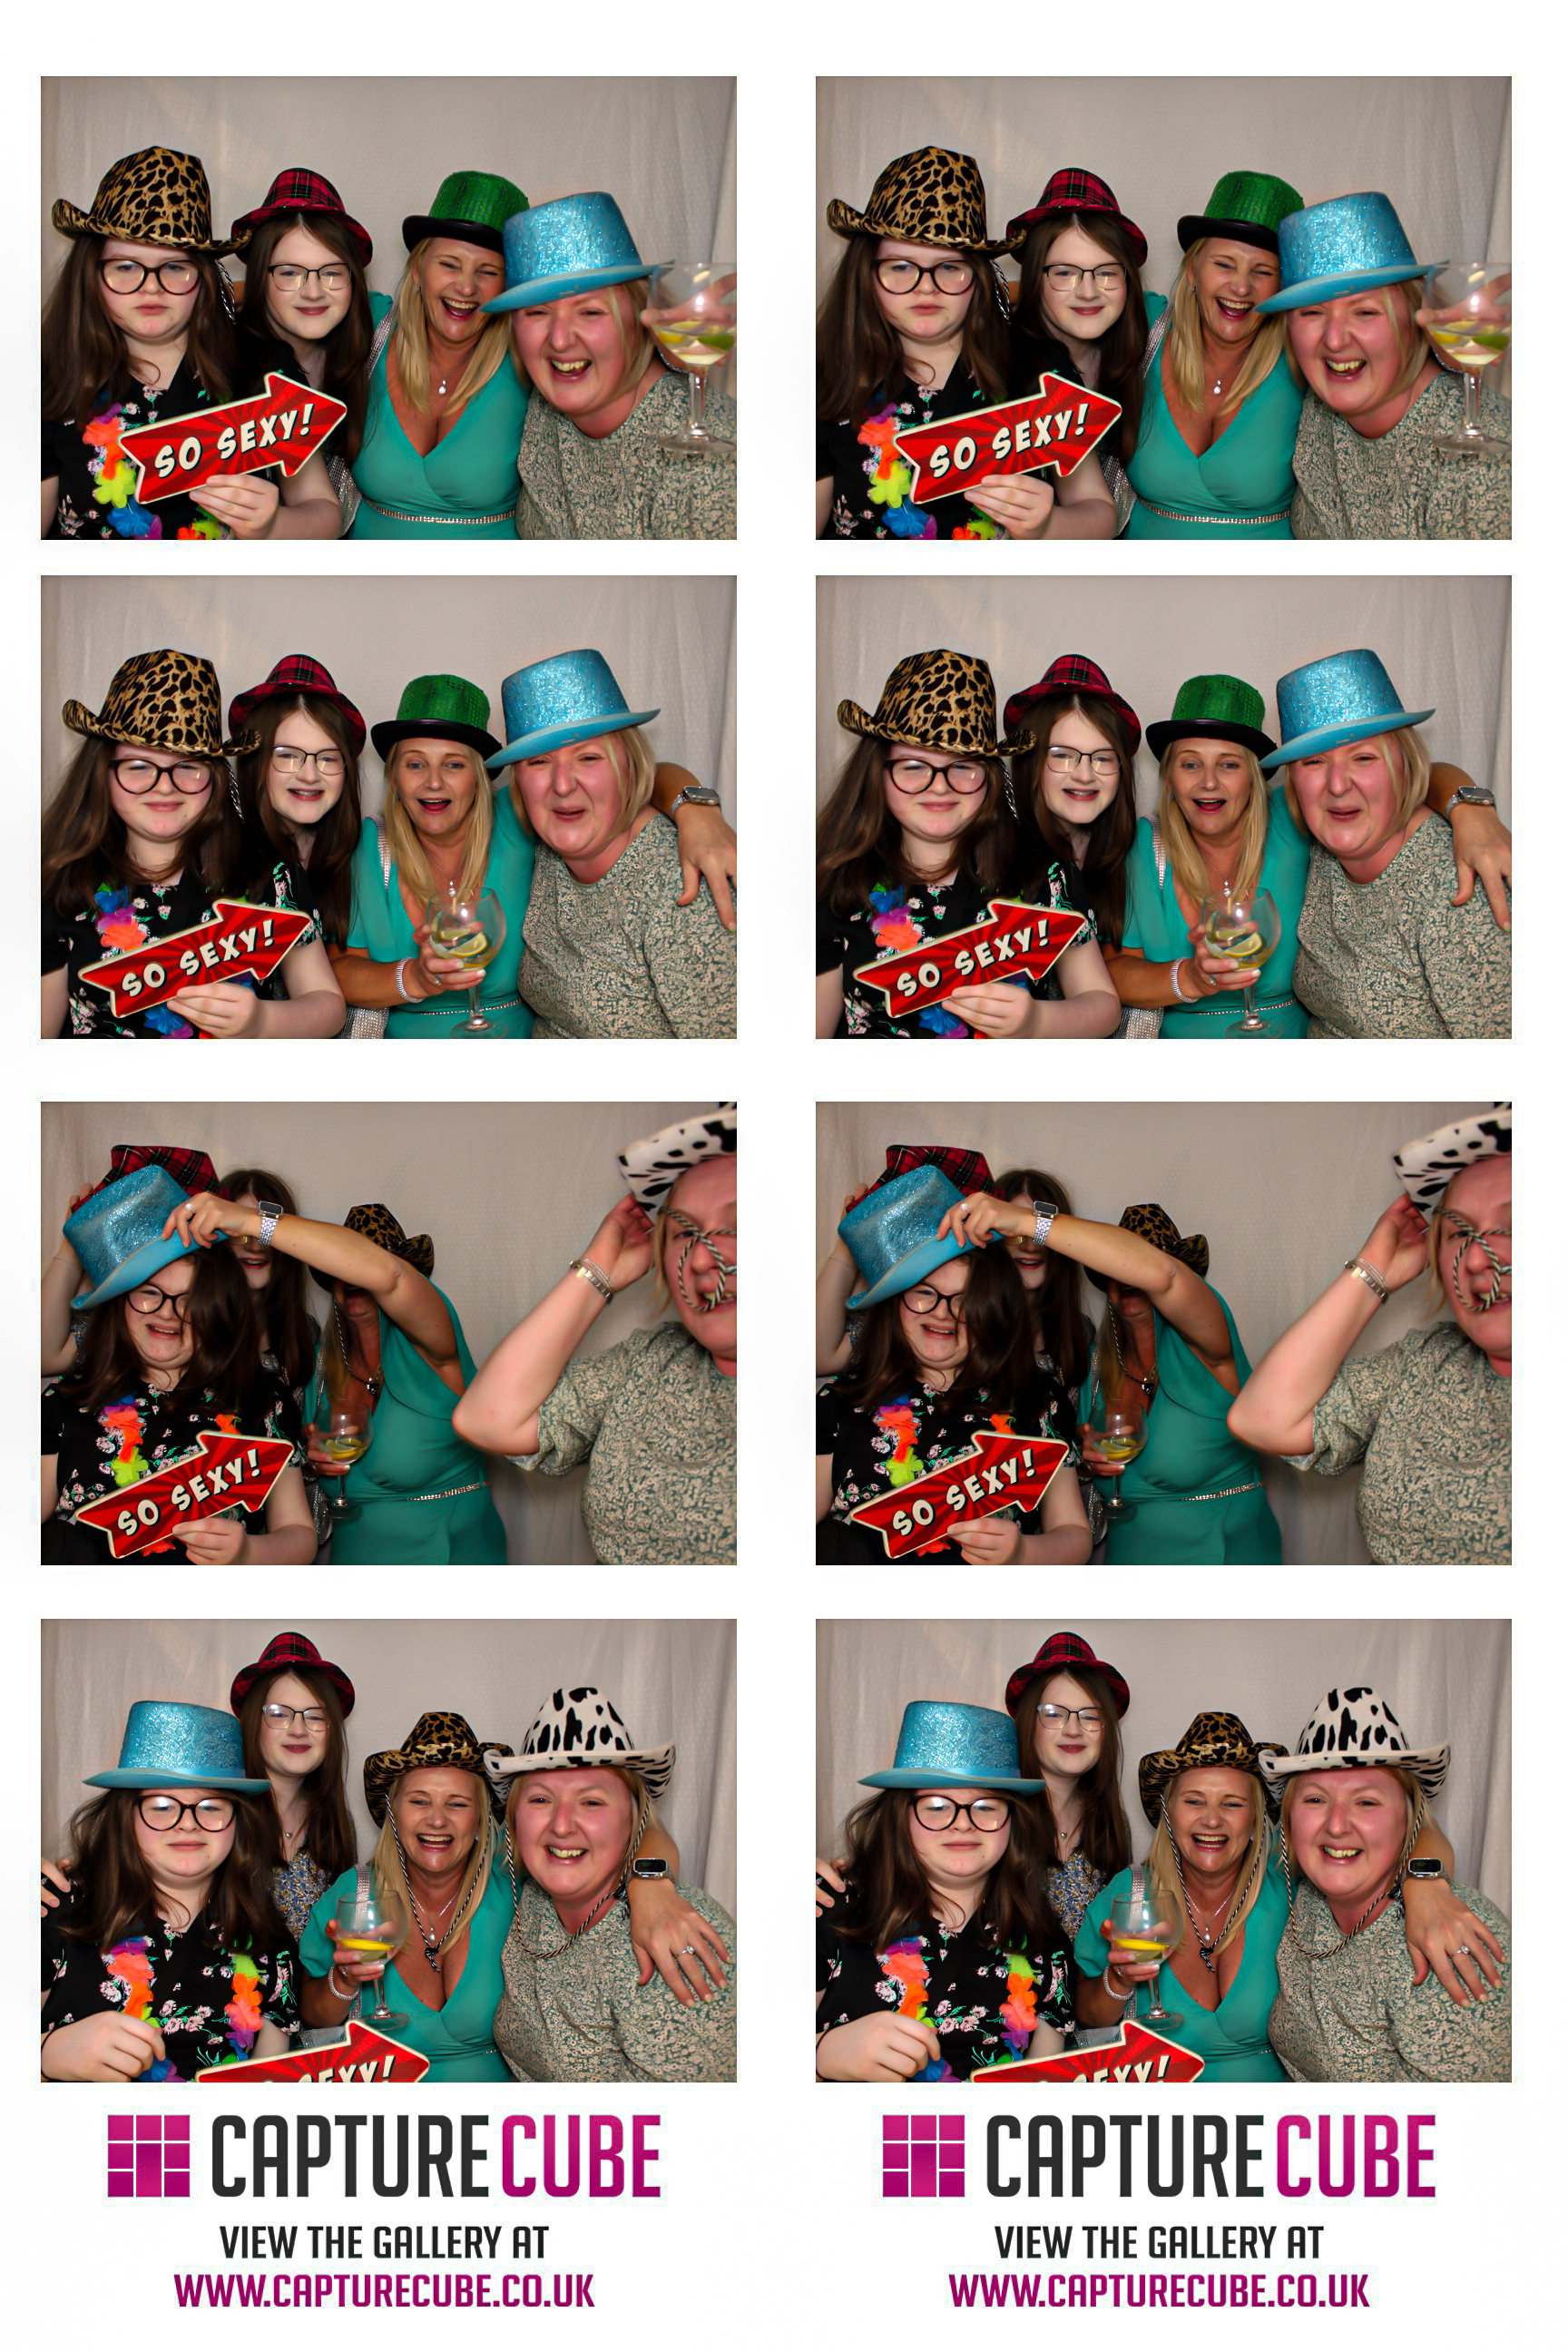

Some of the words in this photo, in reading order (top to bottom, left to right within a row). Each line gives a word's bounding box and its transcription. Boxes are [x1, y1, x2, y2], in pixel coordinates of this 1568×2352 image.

[154, 436, 202, 478] SO
[217, 403, 315, 460] SEXY!
[929, 436, 977, 478] SO
[992, 403, 1090, 460] SEXY!
[122, 963, 166, 997] SO
[179, 919, 275, 975] SEXY!
[897, 963, 941, 997] SO
[954, 919, 1050, 975] SEXY!
[117, 1499, 160, 1536] SO
[171, 1448, 261, 1511] SEXY!
[892, 1499, 935, 1536] SO
[946, 1448, 1036, 1511] SEXY!
